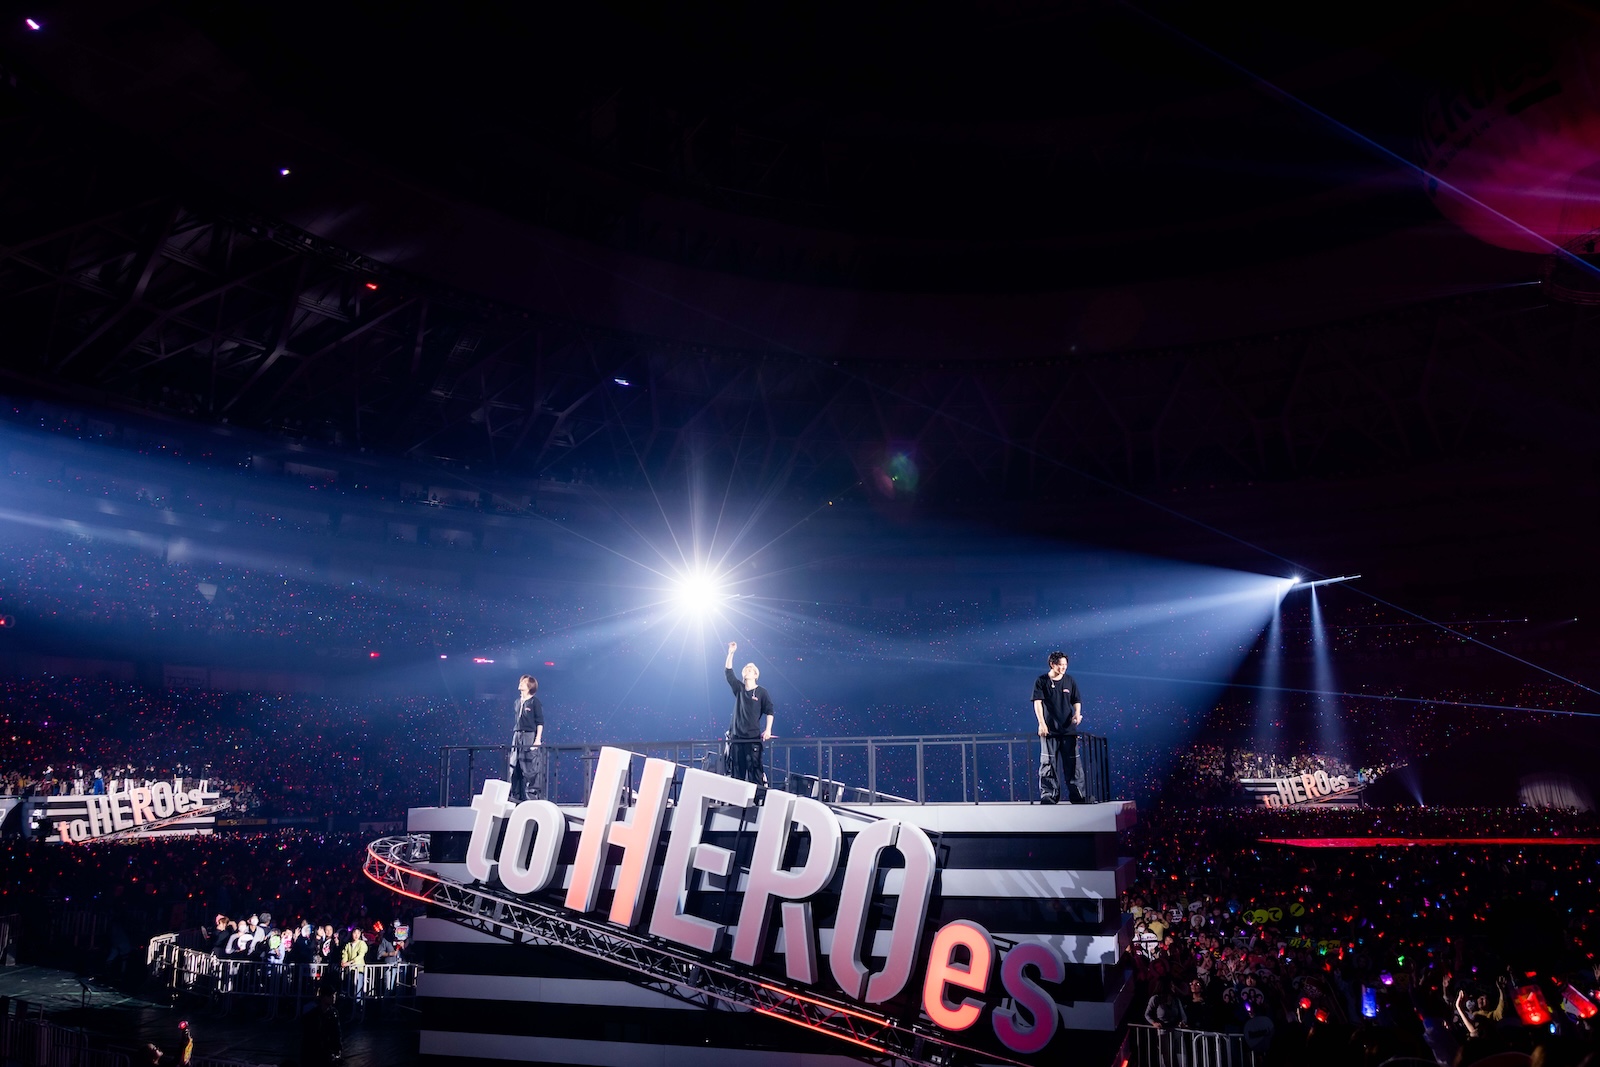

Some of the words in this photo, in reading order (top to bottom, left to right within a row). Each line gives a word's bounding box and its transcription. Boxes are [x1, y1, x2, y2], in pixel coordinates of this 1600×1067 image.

[57, 819, 87, 843] to
[86, 782, 203, 837] HEROes
[1275, 770, 1350, 806] HEROes
[465, 778, 566, 894] to
[563, 745, 1067, 1055] HEROes
